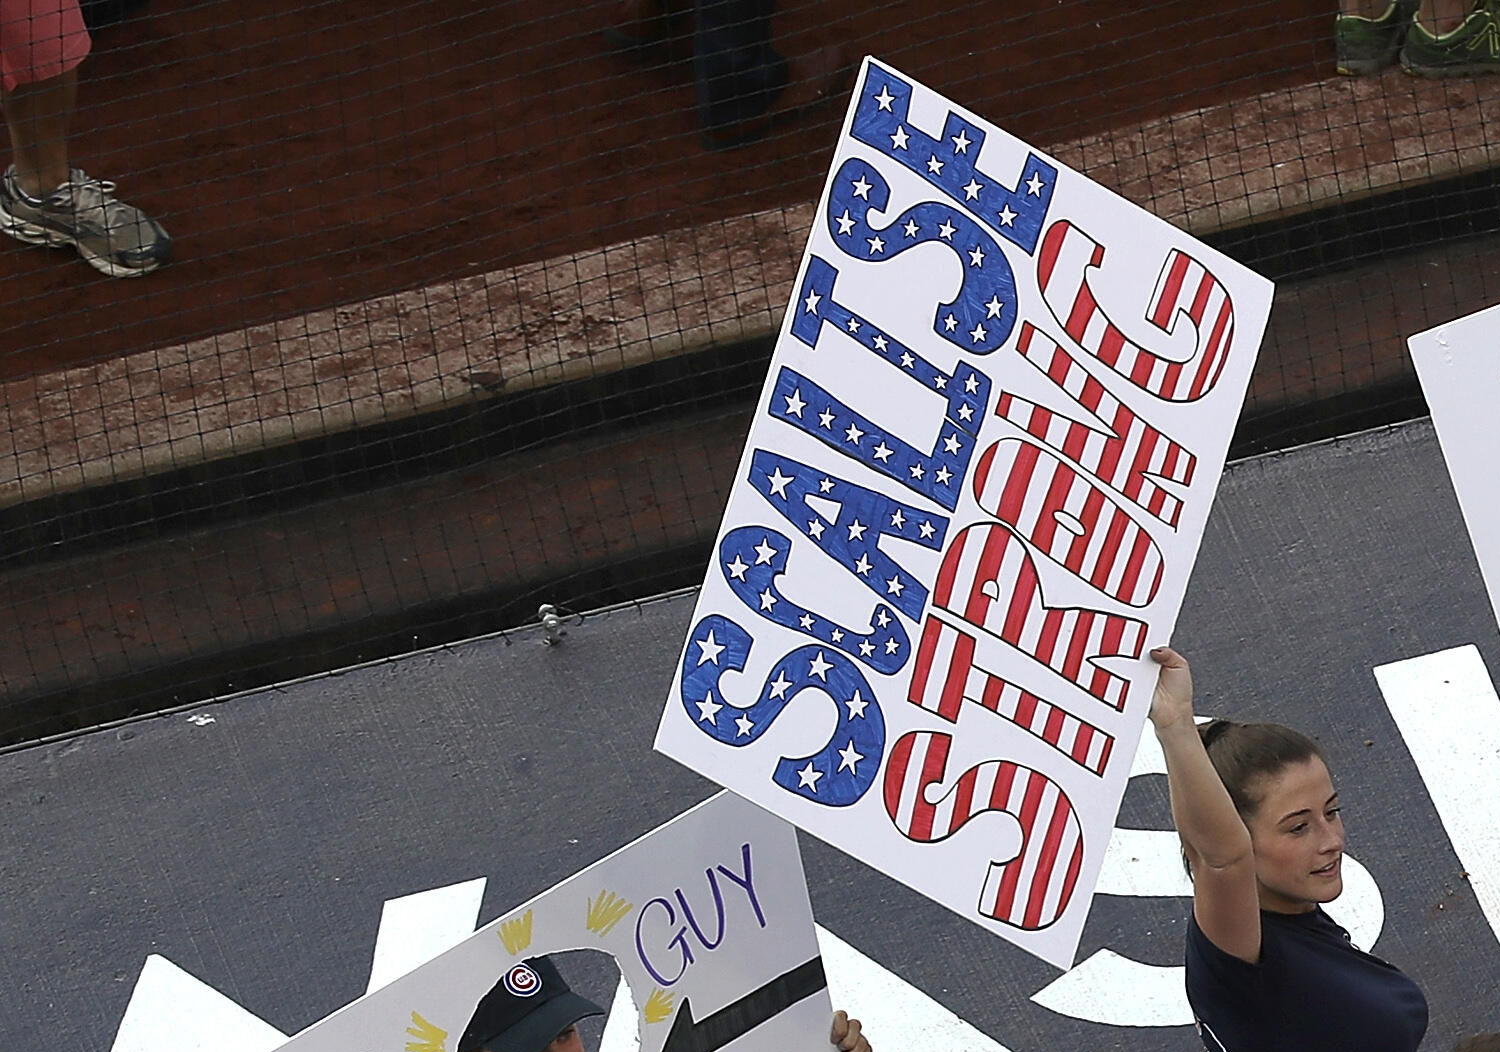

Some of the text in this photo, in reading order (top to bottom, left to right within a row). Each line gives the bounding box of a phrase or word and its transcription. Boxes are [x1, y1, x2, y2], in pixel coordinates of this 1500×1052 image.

[682, 61, 1058, 807] SCALISE
[883, 219, 1235, 932] STRONG
[634, 842, 769, 987] GUY
